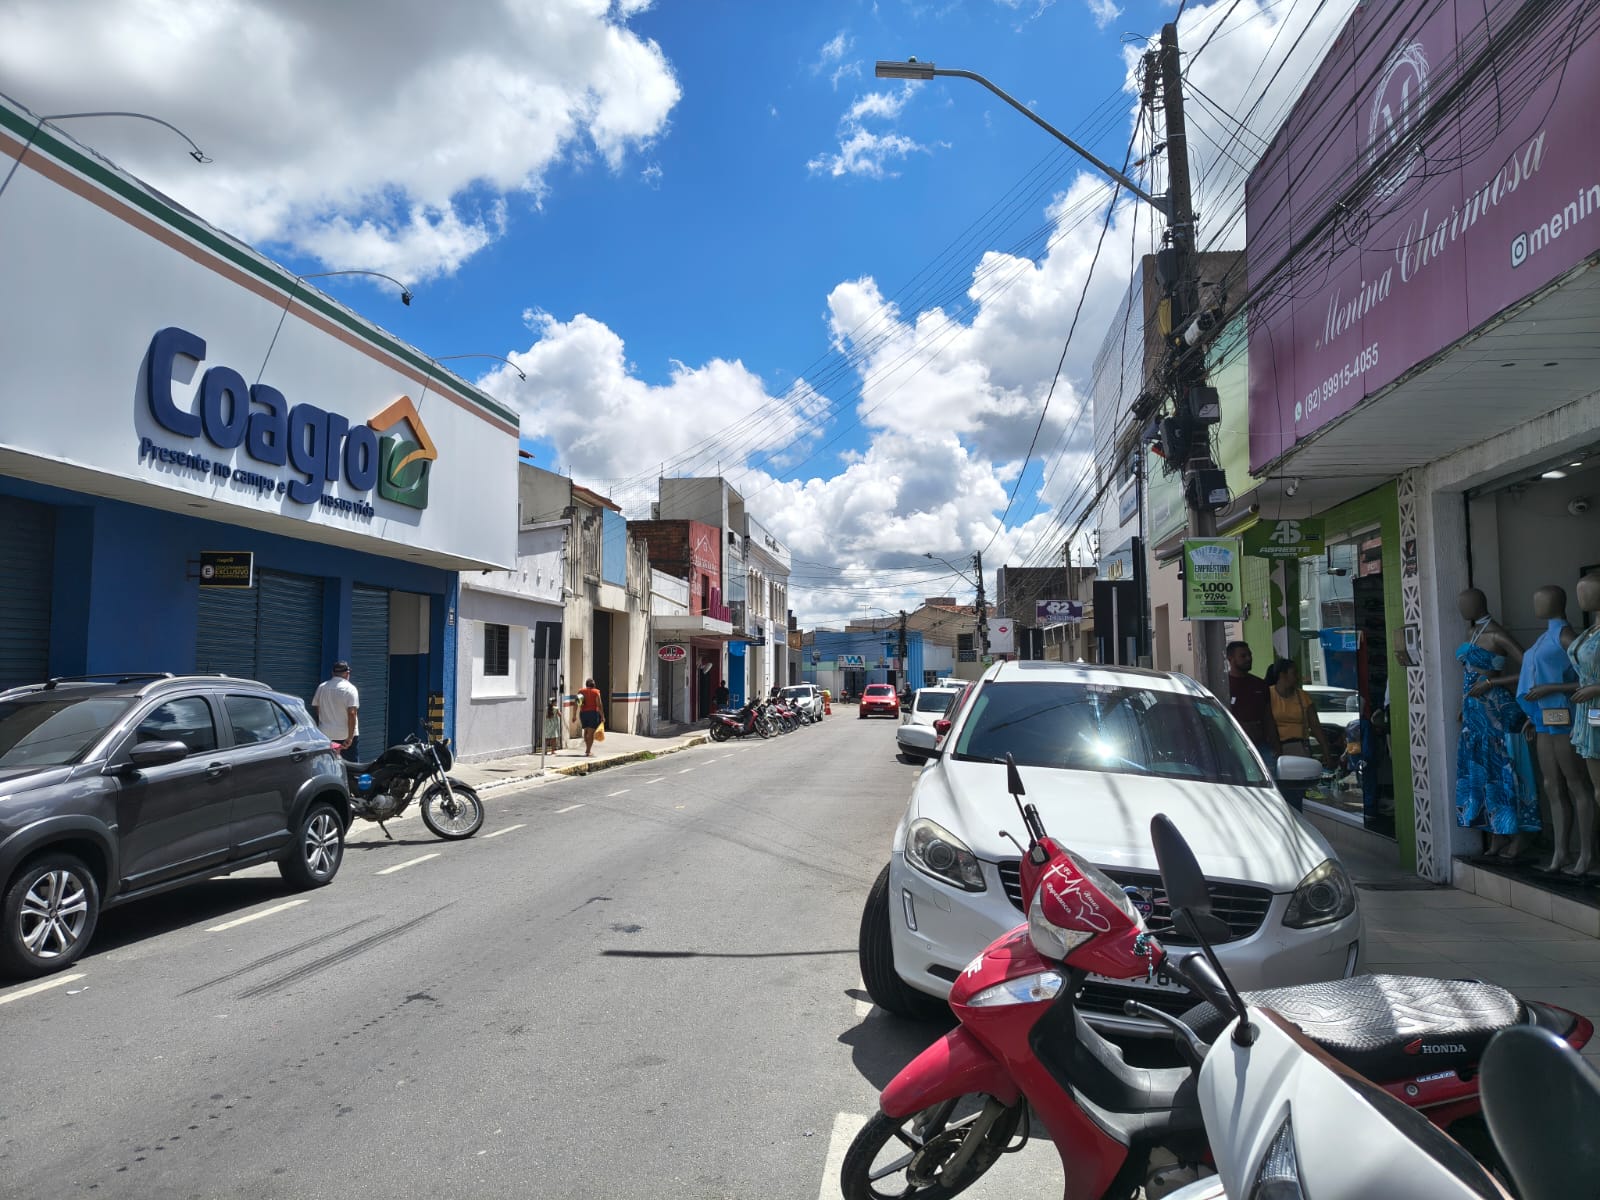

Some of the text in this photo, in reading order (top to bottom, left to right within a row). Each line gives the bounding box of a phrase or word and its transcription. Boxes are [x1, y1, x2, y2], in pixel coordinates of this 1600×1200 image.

[1315, 130, 1549, 352] Menina Charmosa
[147, 326, 378, 504] Coagro
[1305, 341, 1379, 420] (82) 99915-4055
[141, 436, 211, 473] Presente
[213, 461, 231, 479] no
[232, 468, 276, 494] campo
[276, 480, 286, 494] e
[352, 499, 375, 518] vida
[1200, 582, 1233, 593] 1.000
[1203, 592, 1226, 601] 97,96
[1422, 1044, 1468, 1054] HONDA
